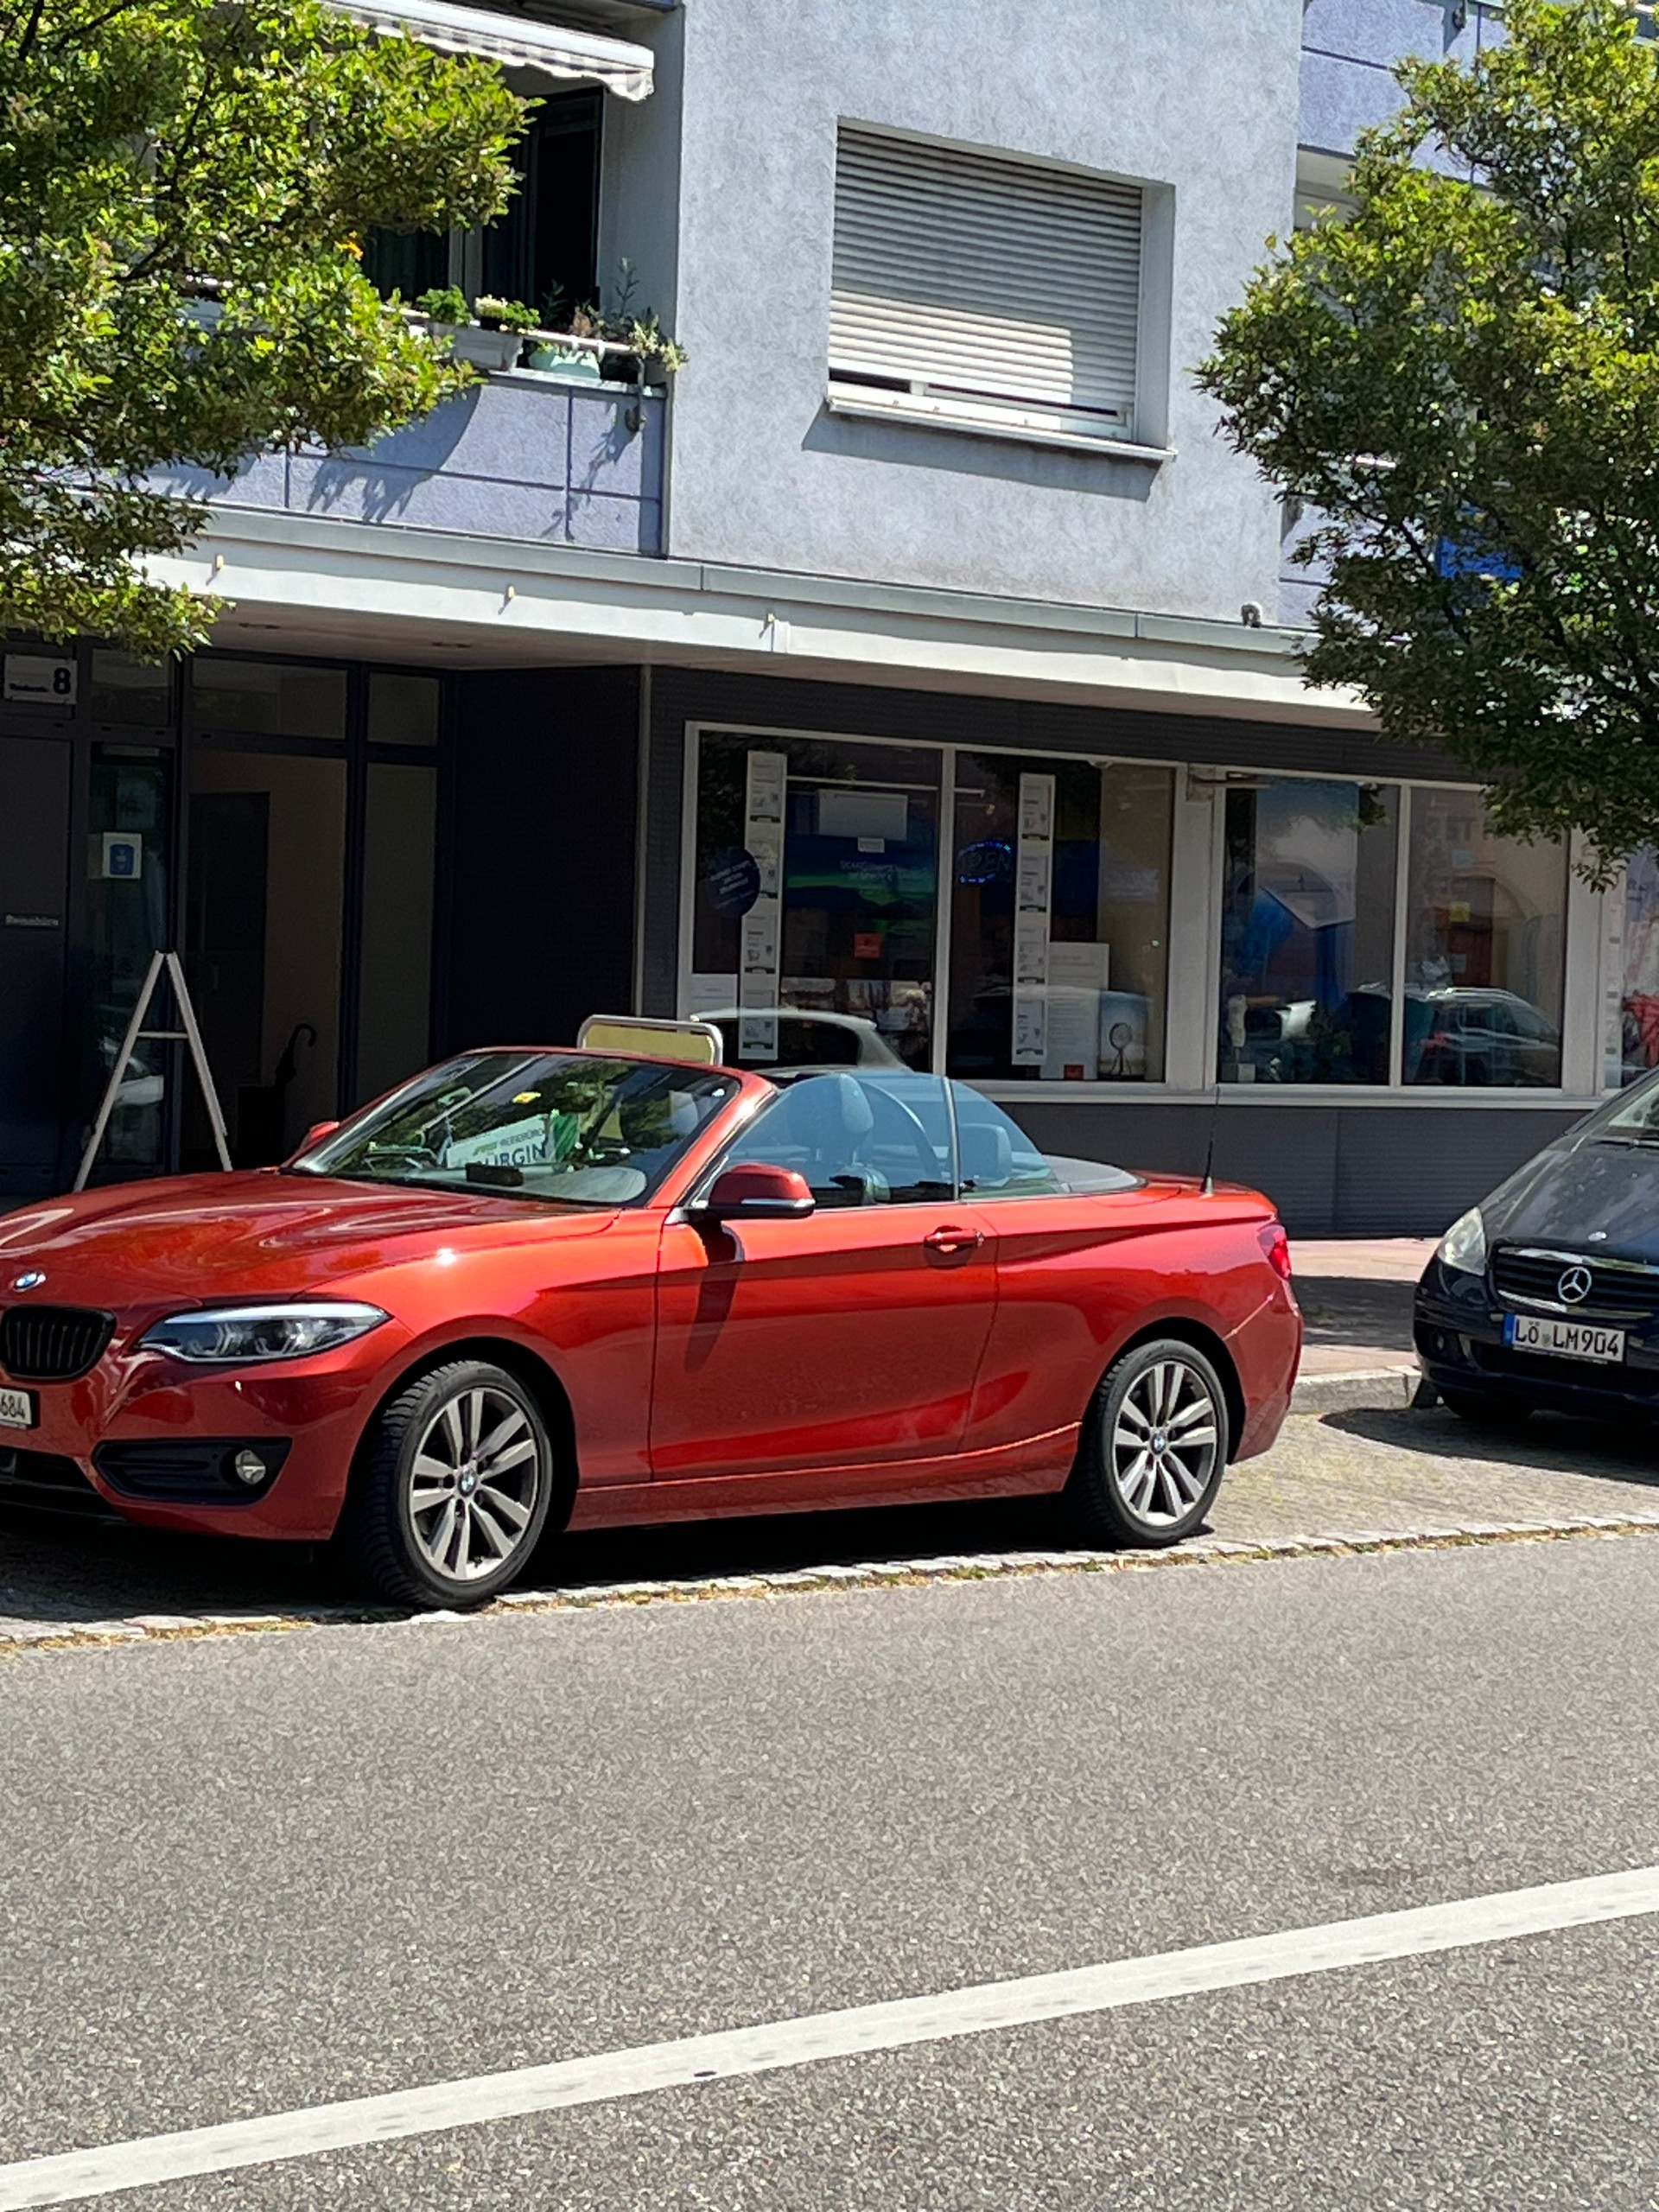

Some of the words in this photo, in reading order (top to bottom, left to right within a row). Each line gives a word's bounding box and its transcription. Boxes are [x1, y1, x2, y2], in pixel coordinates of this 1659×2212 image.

[54, 667, 71, 695] 8
[476, 1139, 546, 1166] ÜRGIN
[1516, 1318, 1540, 1344] LÖ
